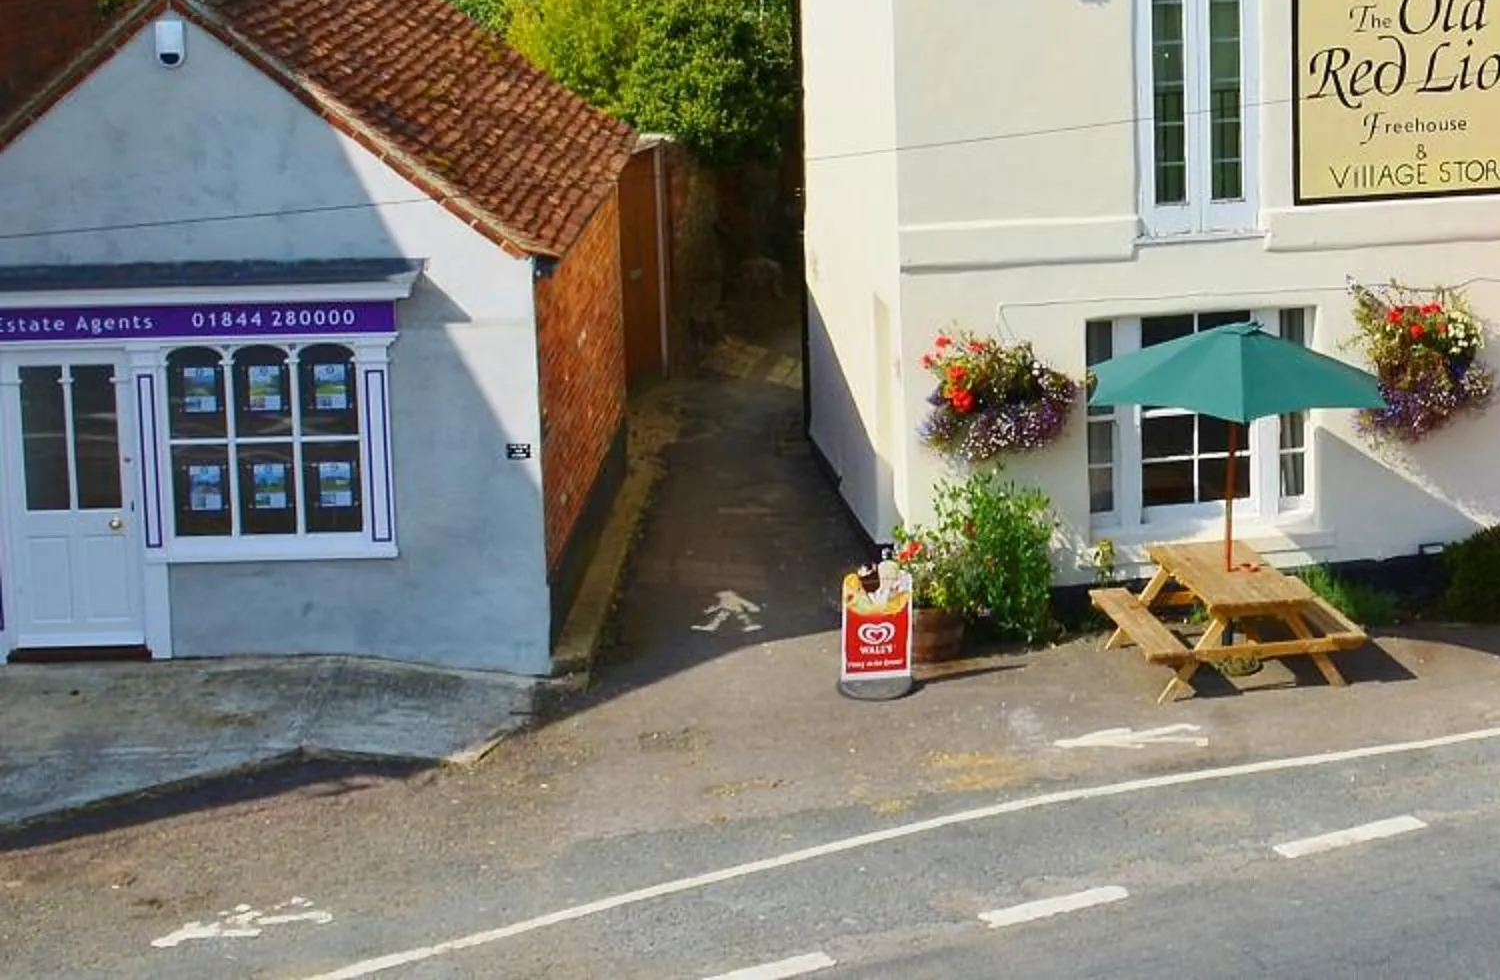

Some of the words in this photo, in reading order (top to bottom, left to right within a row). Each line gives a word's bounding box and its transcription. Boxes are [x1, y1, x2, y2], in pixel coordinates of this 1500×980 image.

[1349, 4, 1392, 33] The
[1306, 35, 1407, 109] Red
[1359, 111, 1467, 145] Freehouse
[75, 315, 153, 335] Agents
[191, 310, 262, 328] 01844
[271, 308, 355, 327] 280000
